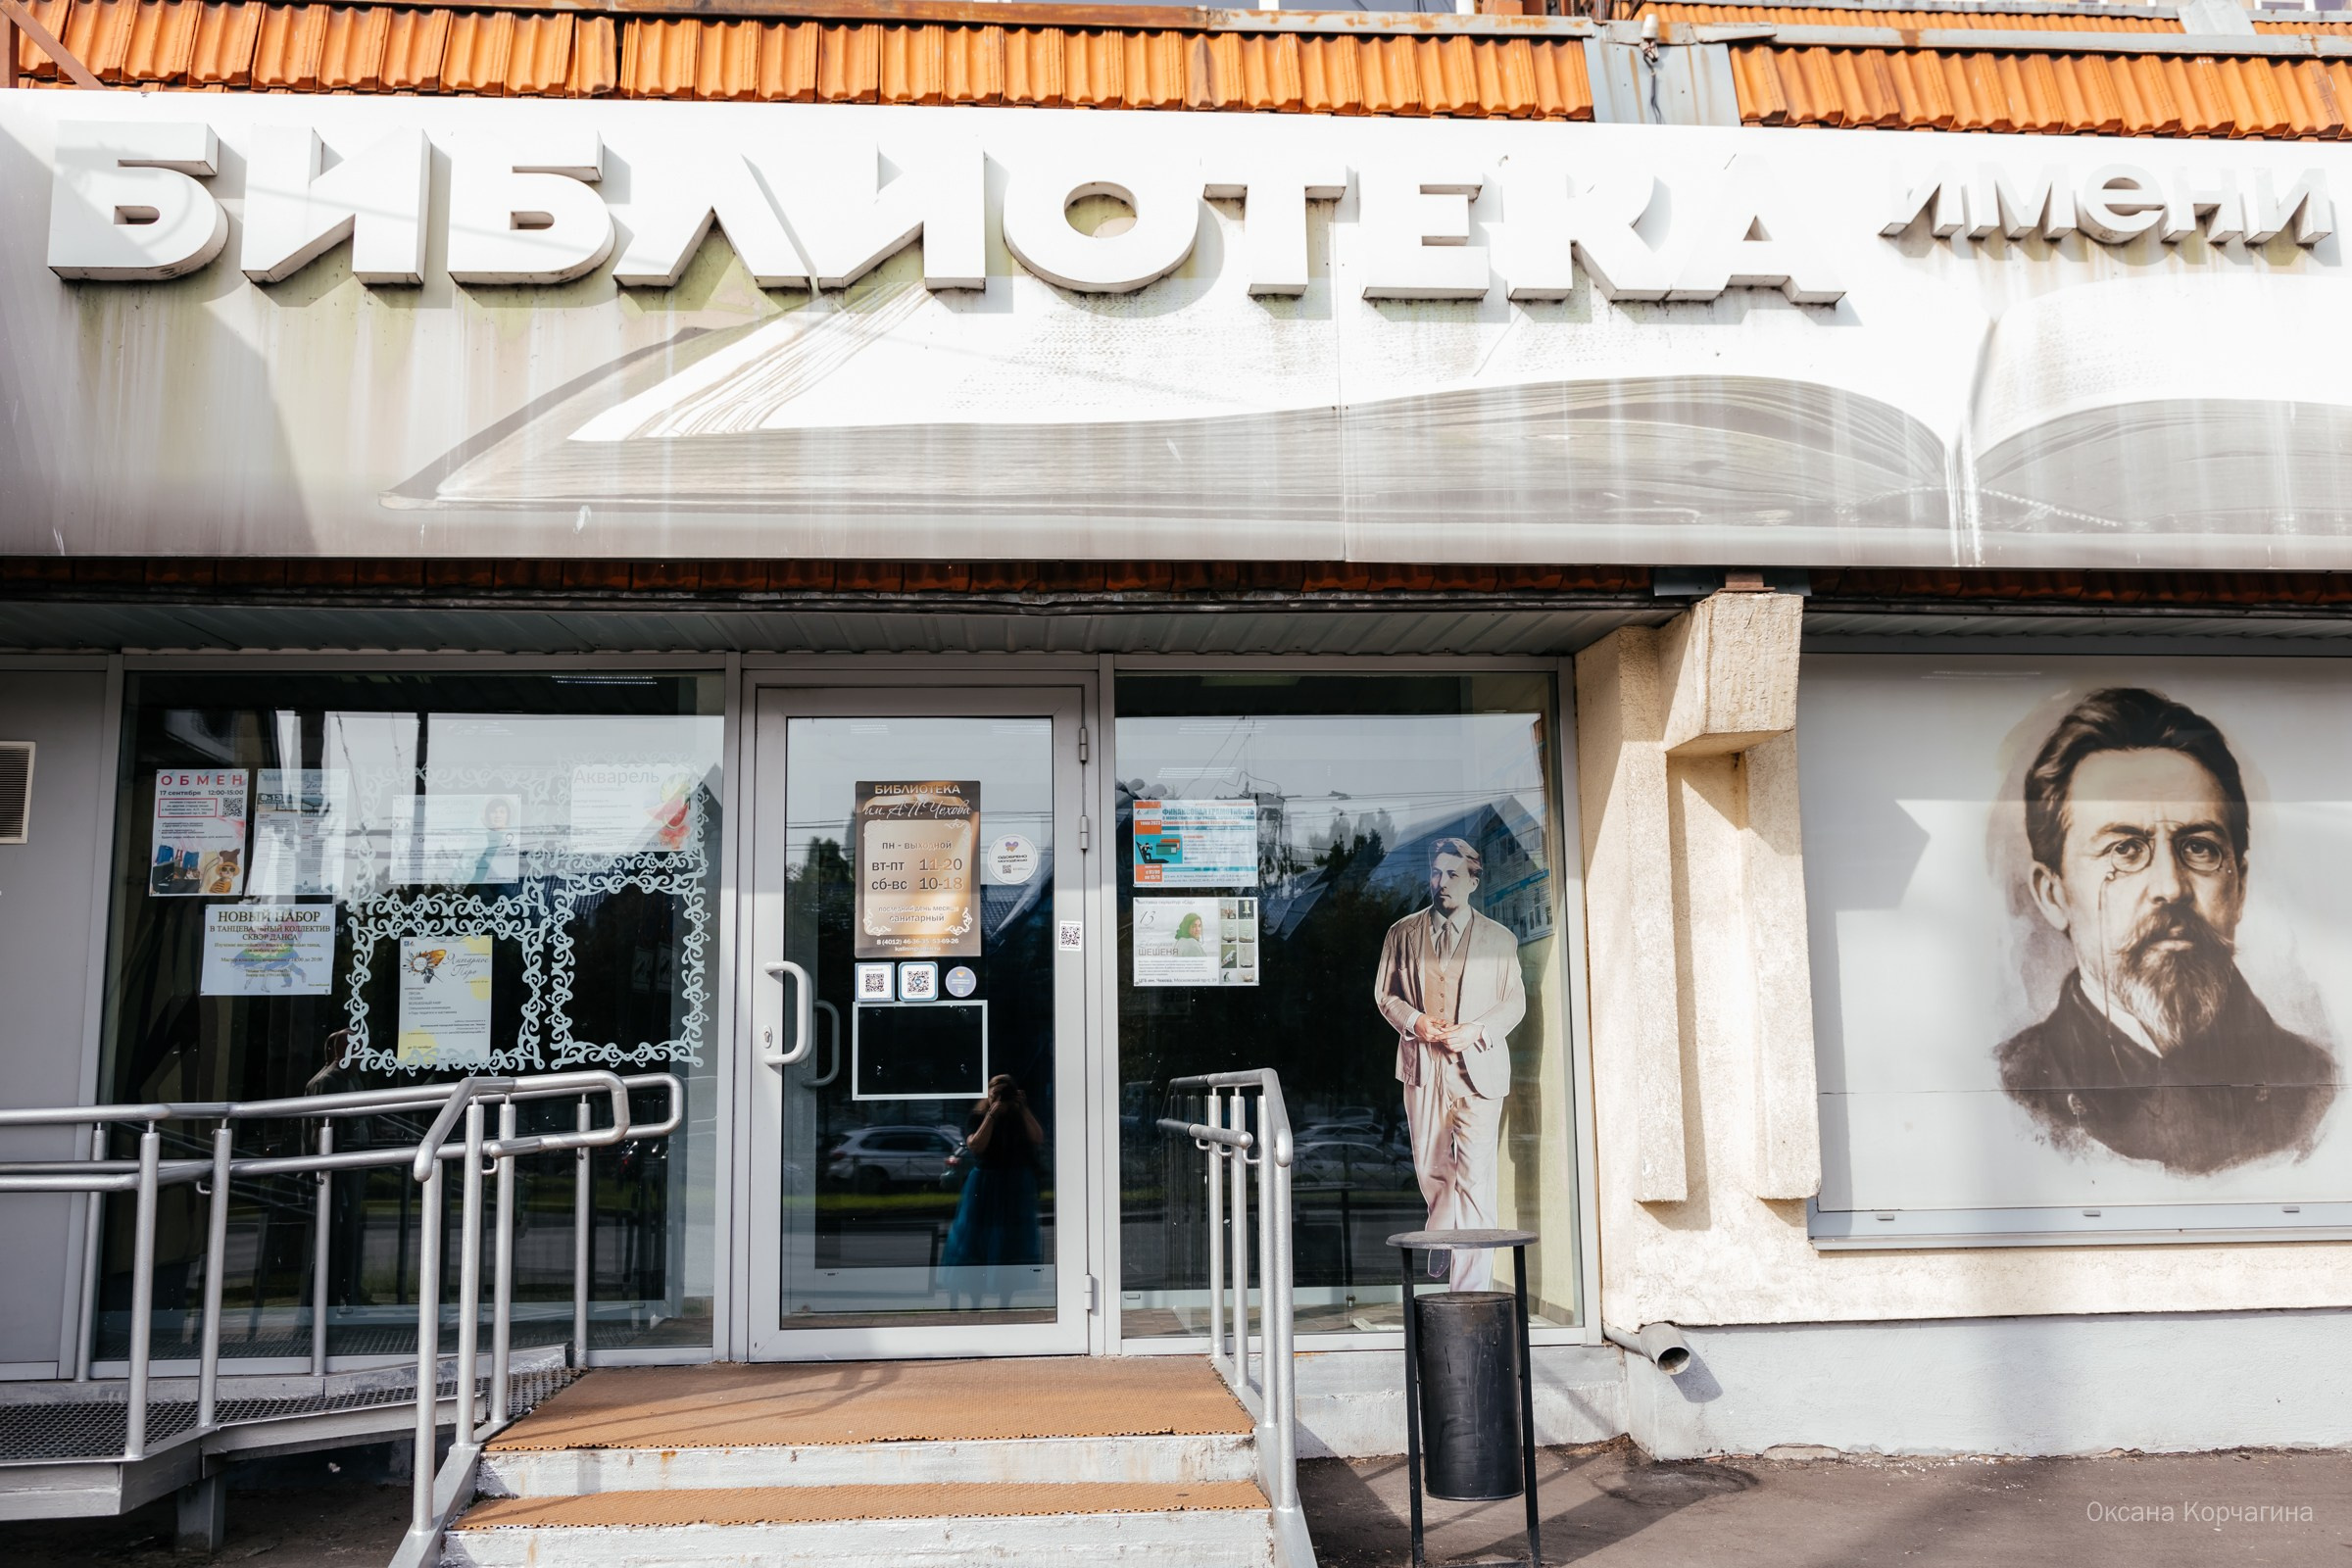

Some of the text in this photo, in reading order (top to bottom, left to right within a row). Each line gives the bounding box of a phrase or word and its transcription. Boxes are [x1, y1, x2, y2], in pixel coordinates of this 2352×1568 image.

[47, 119, 2334, 305] БИБЛИОТЕКА имени
[160, 774, 243, 786] ОБМЕН
[573, 769, 661, 787] Акварель
[874, 784, 961, 795] БИБЛИОТЕКА
[864, 807, 885, 815] им.
[923, 799, 972, 819] Чехова
[905, 841, 952, 851] выходной
[872, 858, 962, 871] вт-пт 11-20
[871, 877, 963, 890] сб-вс 10-18
[218, 909, 321, 922] НОВЫЙ НАБОР
[889, 913, 945, 923] санитарный
[1140, 910, 1156, 926] 13
[218, 923, 283, 933] ТАНЦЕВАЬНЫЙ
[270, 933, 298, 942] ДАНСА
[1138, 948, 1179, 956] ШЕШЕНЯ
[442, 953, 489, 966] Янтарное
